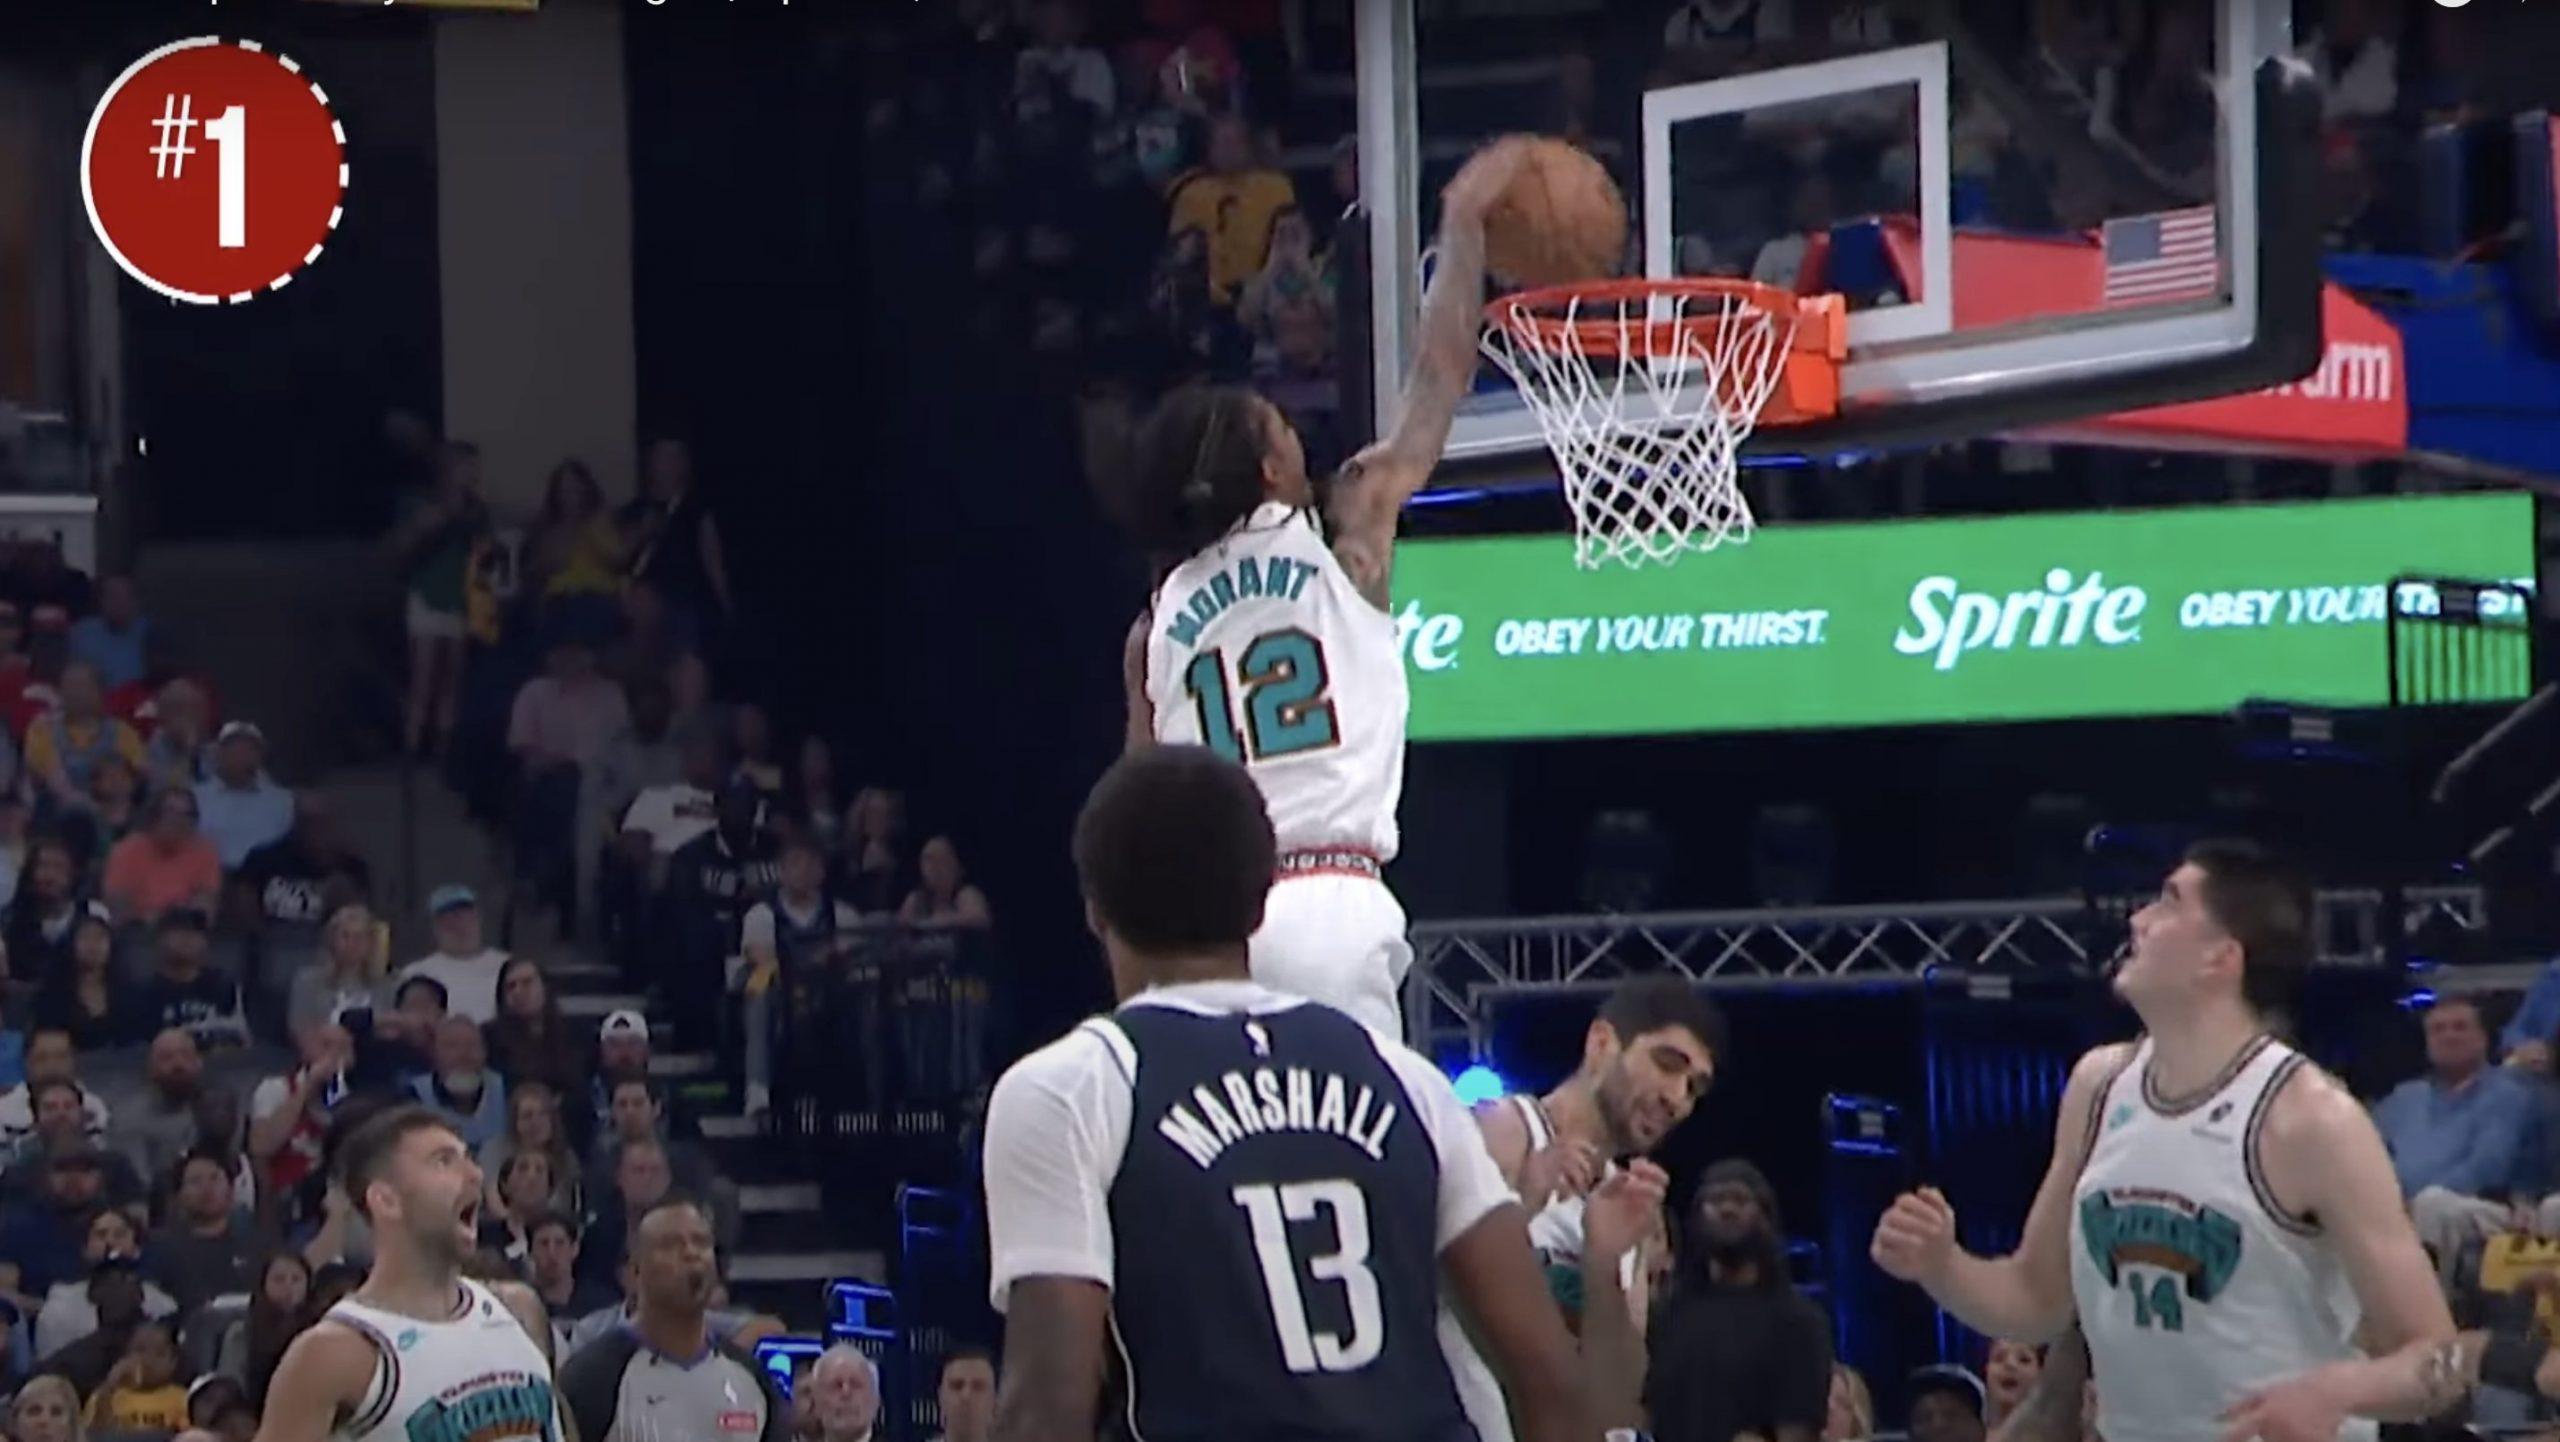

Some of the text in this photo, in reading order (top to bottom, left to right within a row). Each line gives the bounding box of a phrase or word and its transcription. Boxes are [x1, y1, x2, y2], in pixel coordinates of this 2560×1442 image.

[1165, 556, 1320, 649] MORANT
[1394, 600, 1464, 671] te
[1494, 618, 1591, 656] OBEY
[1597, 614, 1693, 653] YOUR
[1893, 567, 2147, 670] Sprite
[2180, 590, 2281, 627] OBEY
[2287, 584, 2387, 624] YOUR
[1184, 625, 1341, 765] 12
[1158, 1067, 1397, 1170] MARSHALL
[1231, 1178, 1385, 1373] 13
[2128, 1271, 2183, 1332] 14
